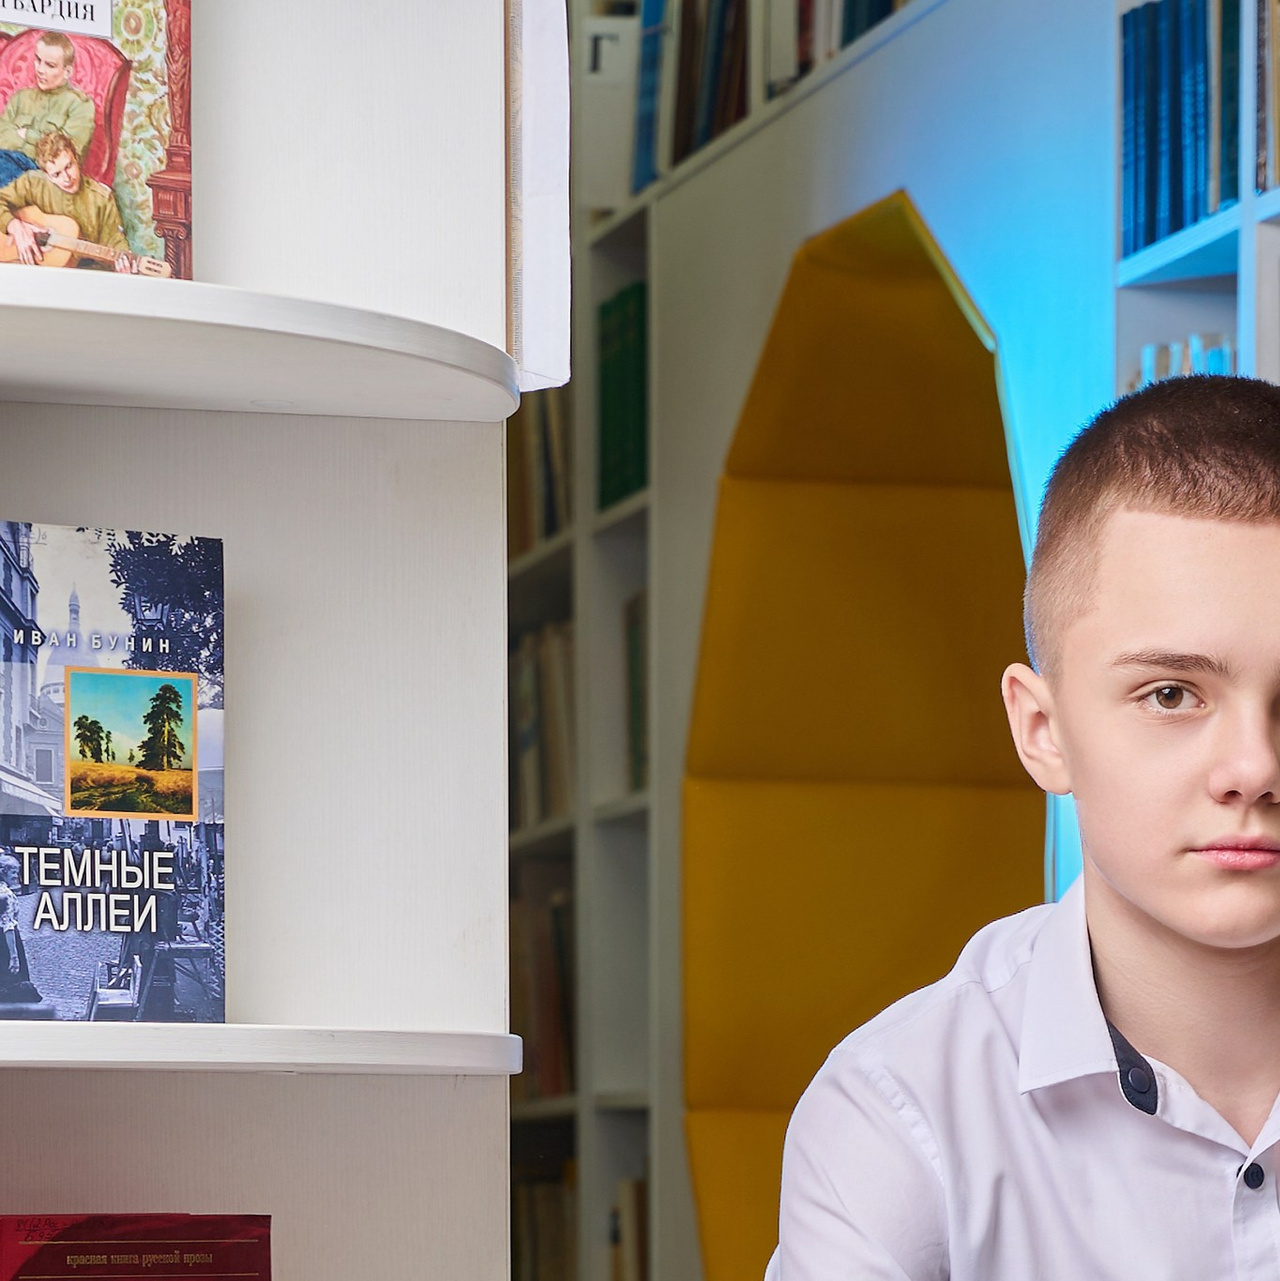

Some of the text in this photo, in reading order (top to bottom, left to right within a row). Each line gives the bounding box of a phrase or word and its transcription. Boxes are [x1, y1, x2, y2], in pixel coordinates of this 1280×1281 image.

[13, 628, 171, 654] ИВАН БУНИН
[14, 846, 175, 890] ТЕМНЫЕ
[33, 891, 158, 933] АЛЛЕИ
[66, 1250, 213, 1268] красная книга русской прозы
